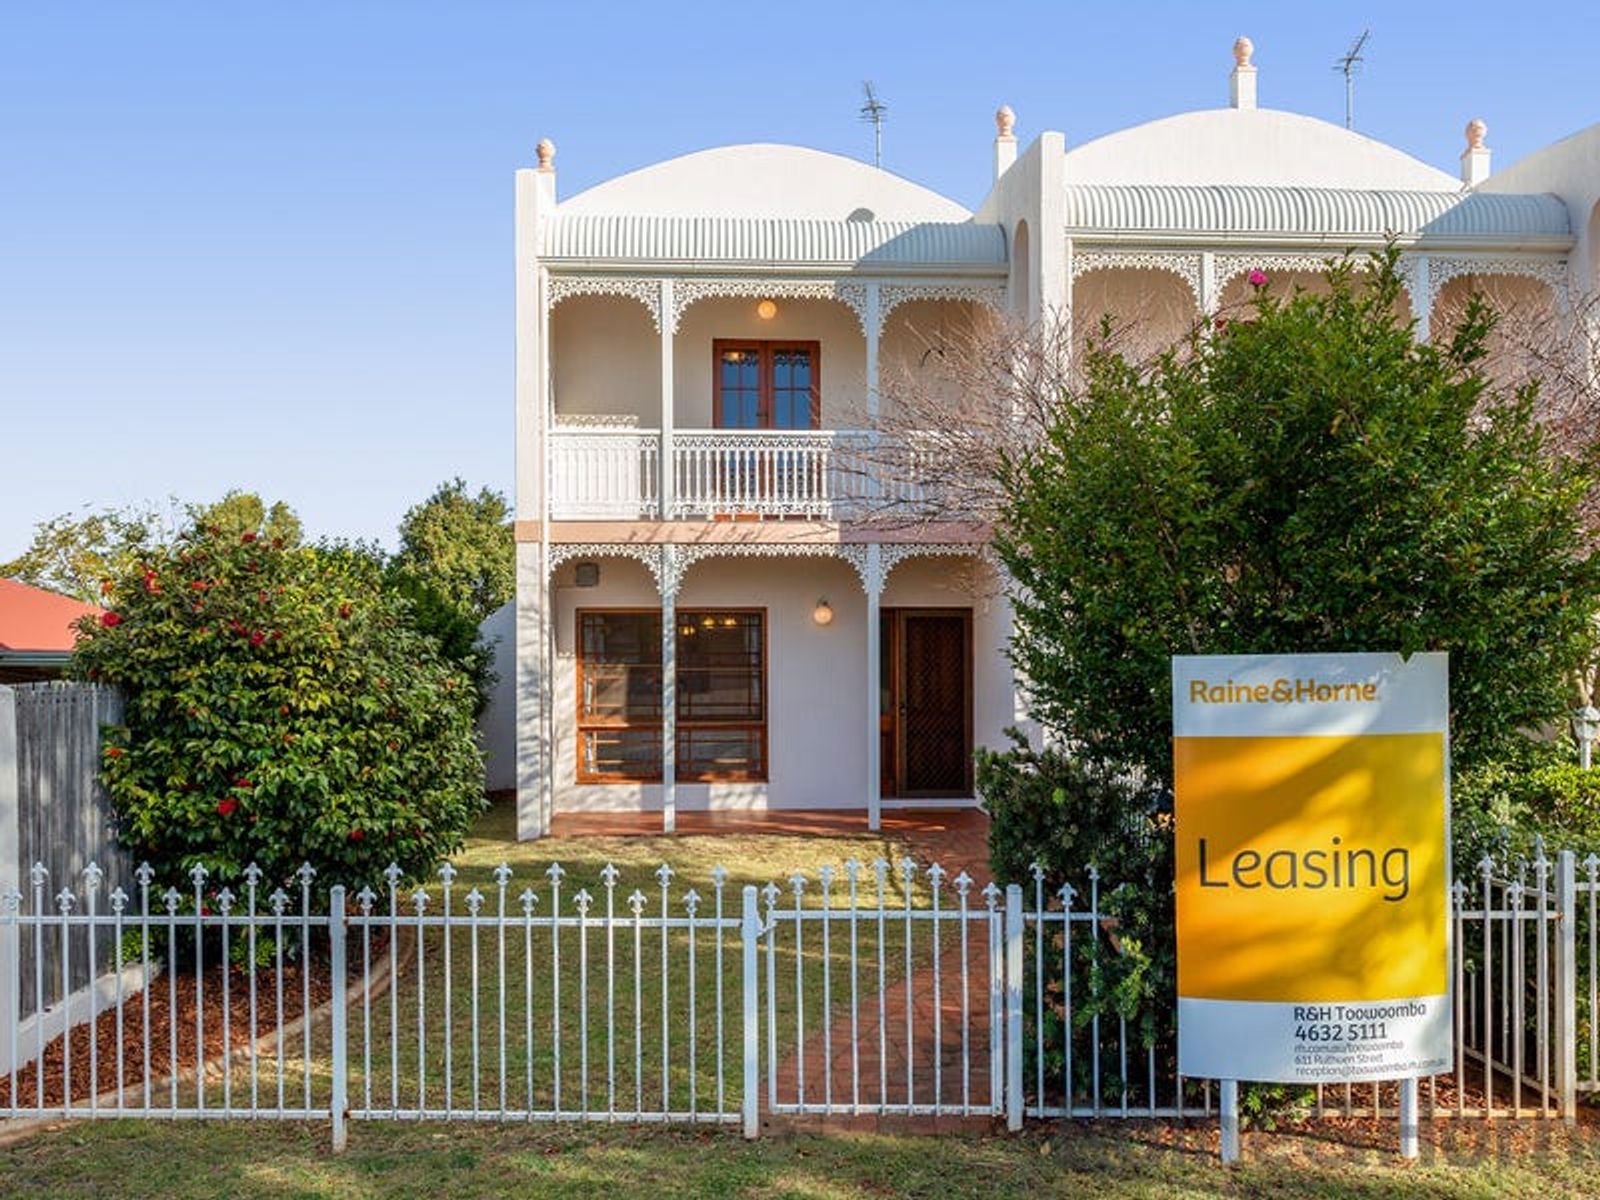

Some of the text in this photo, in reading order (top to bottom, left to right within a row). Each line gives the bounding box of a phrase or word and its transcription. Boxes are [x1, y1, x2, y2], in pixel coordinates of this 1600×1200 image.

[1189, 677, 1377, 704] Raine&Horne
[1199, 836, 1410, 902] Leasing
[1294, 1002, 1427, 1022] R&H Toowoomba
[1295, 1022, 1387, 1042] 4632 5111
[1357, 1053, 1384, 1064] Street
